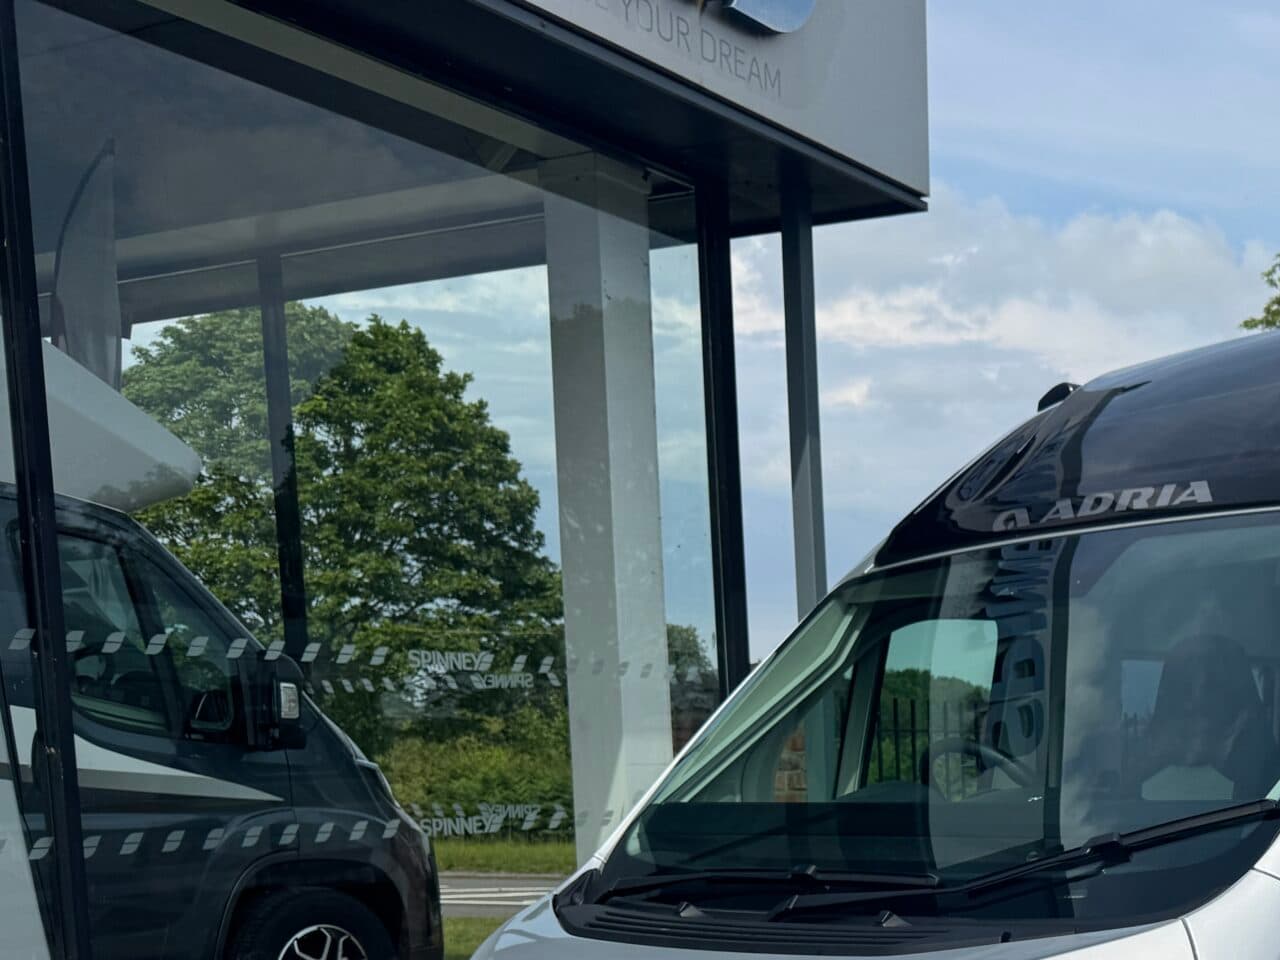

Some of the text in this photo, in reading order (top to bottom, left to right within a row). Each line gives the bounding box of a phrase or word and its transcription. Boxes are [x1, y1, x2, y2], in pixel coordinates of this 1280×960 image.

[622, 0, 781, 97] YOUR DREAM
[1039, 480, 1213, 524] ADRIA
[408, 650, 484, 672] SPINNEY
[421, 815, 495, 836] SPINNEY
